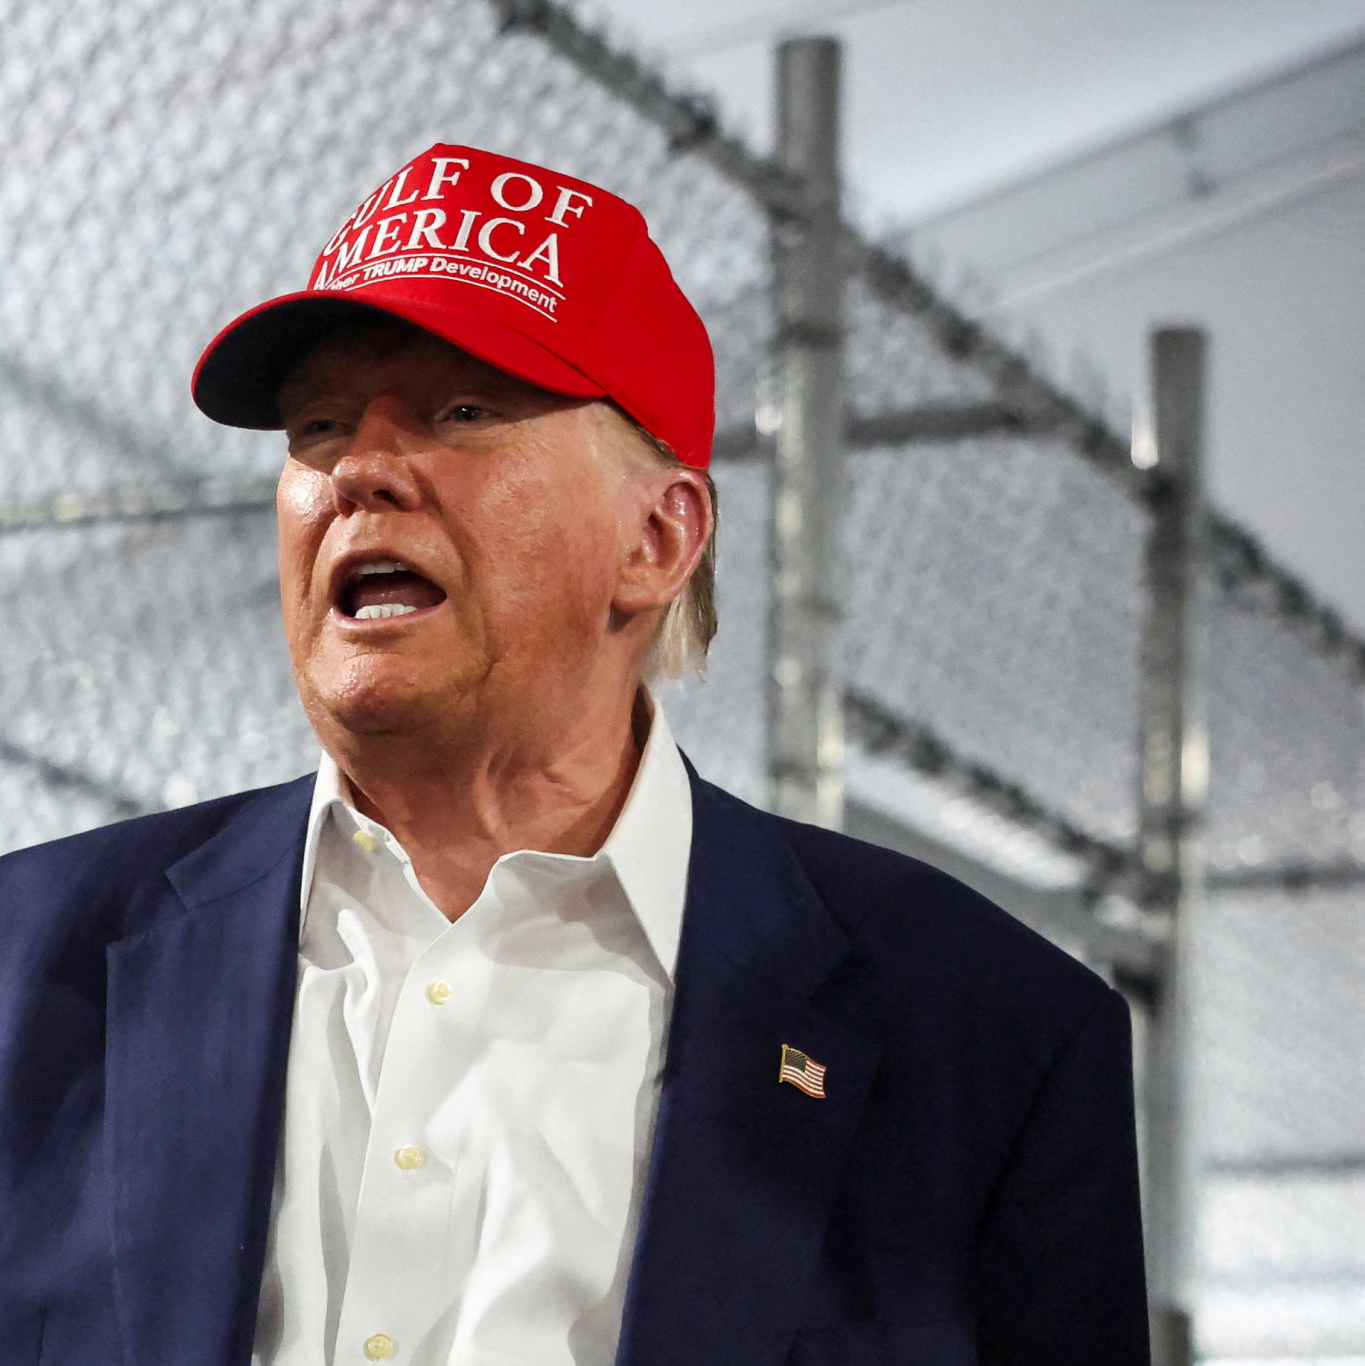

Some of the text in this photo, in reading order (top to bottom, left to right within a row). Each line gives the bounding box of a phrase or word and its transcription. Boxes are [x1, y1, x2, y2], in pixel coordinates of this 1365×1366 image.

[490, 172, 594, 228] OF
[313, 208, 564, 291] AMERICA
[363, 257, 428, 281] TRUMP
[429, 256, 559, 313] Development
